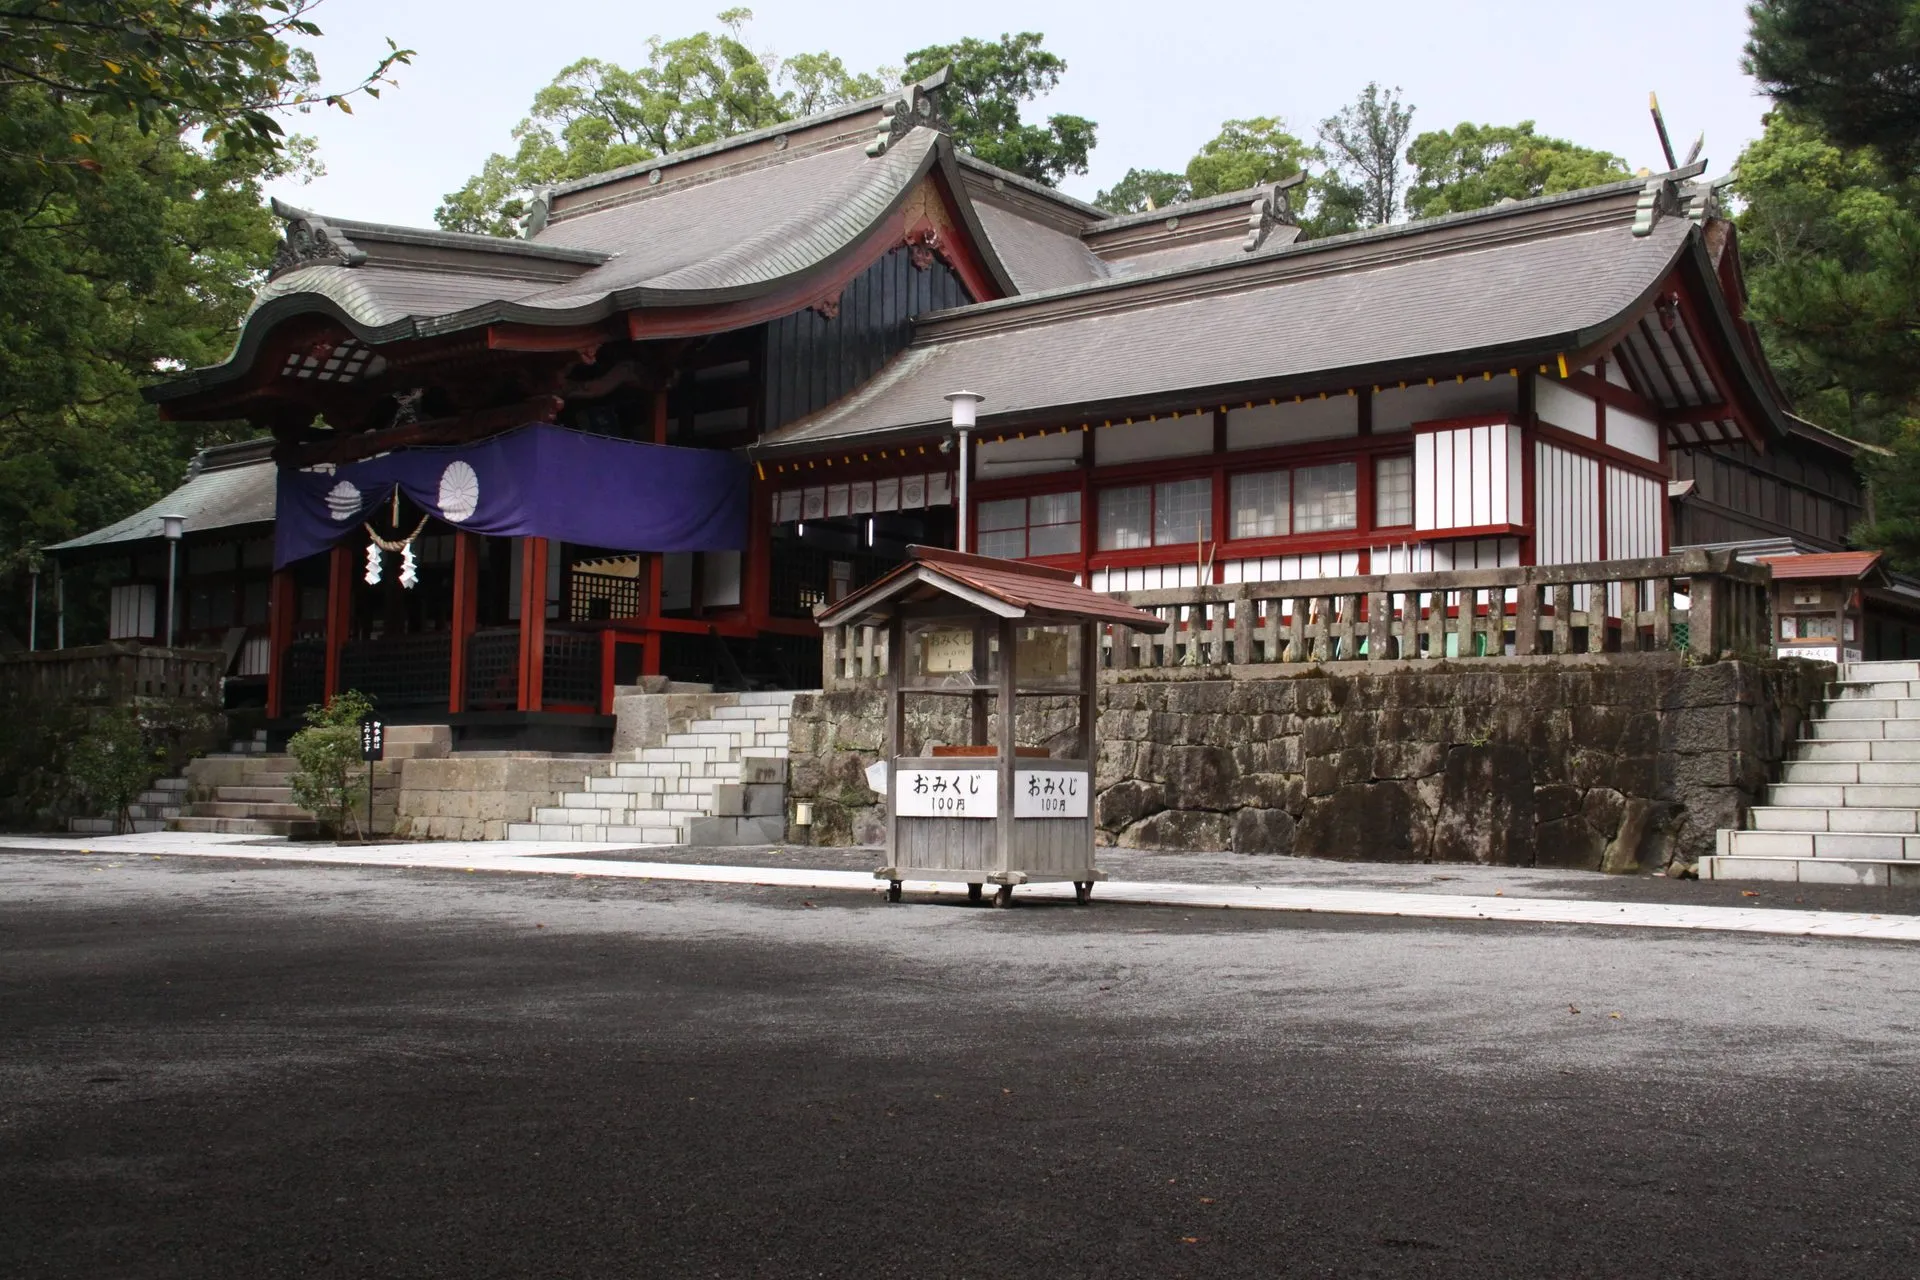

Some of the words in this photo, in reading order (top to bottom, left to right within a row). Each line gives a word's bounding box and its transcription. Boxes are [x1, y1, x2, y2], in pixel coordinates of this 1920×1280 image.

[930, 632, 973, 646] おみくじ
[363, 722, 371, 752] この上です
[913, 774, 981, 795] おみくじ
[1028, 774, 1078, 797] おみくじ
[931, 797, 965, 811] 100円
[1041, 798, 1066, 812] 100円
